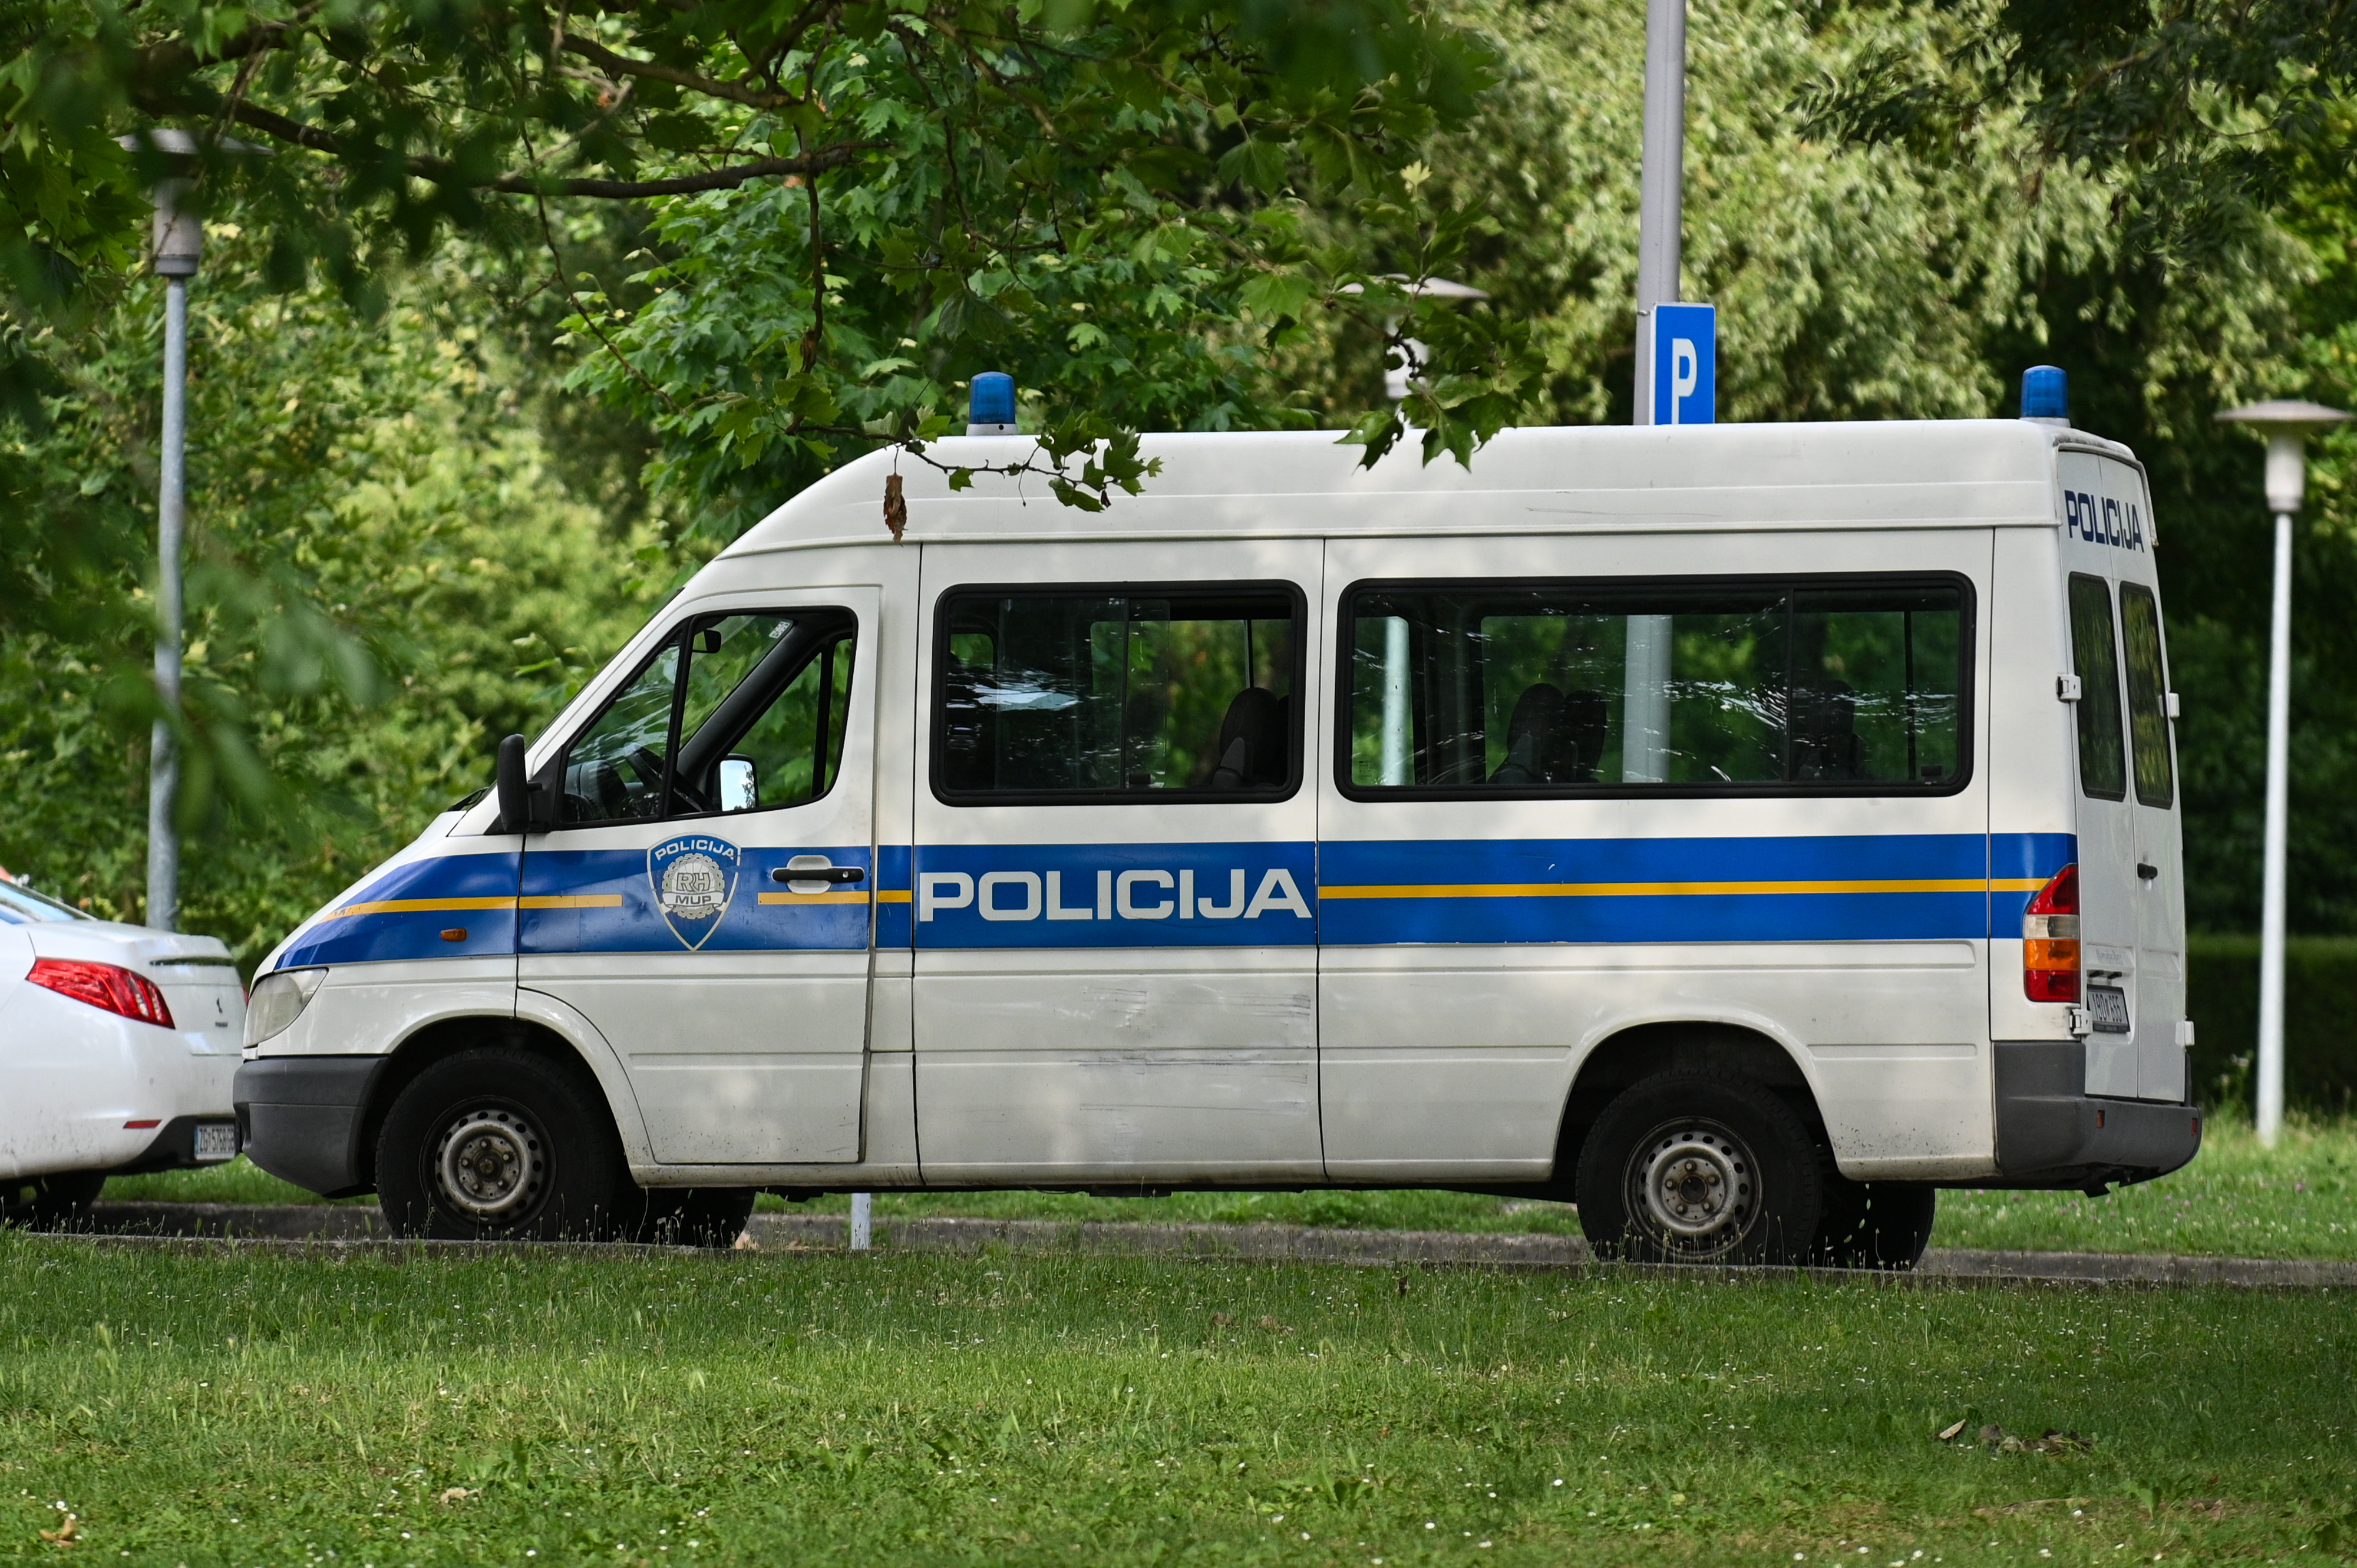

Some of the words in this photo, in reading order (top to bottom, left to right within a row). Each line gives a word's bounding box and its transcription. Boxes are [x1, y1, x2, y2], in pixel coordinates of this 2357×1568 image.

[1672, 338, 1697, 424] P
[2064, 490, 2144, 553] POLICIJA
[655, 840, 734, 860] POLICIJA
[675, 895, 711, 905] MUP
[676, 873, 711, 892] RH
[919, 869, 1312, 922] POLICIJA
